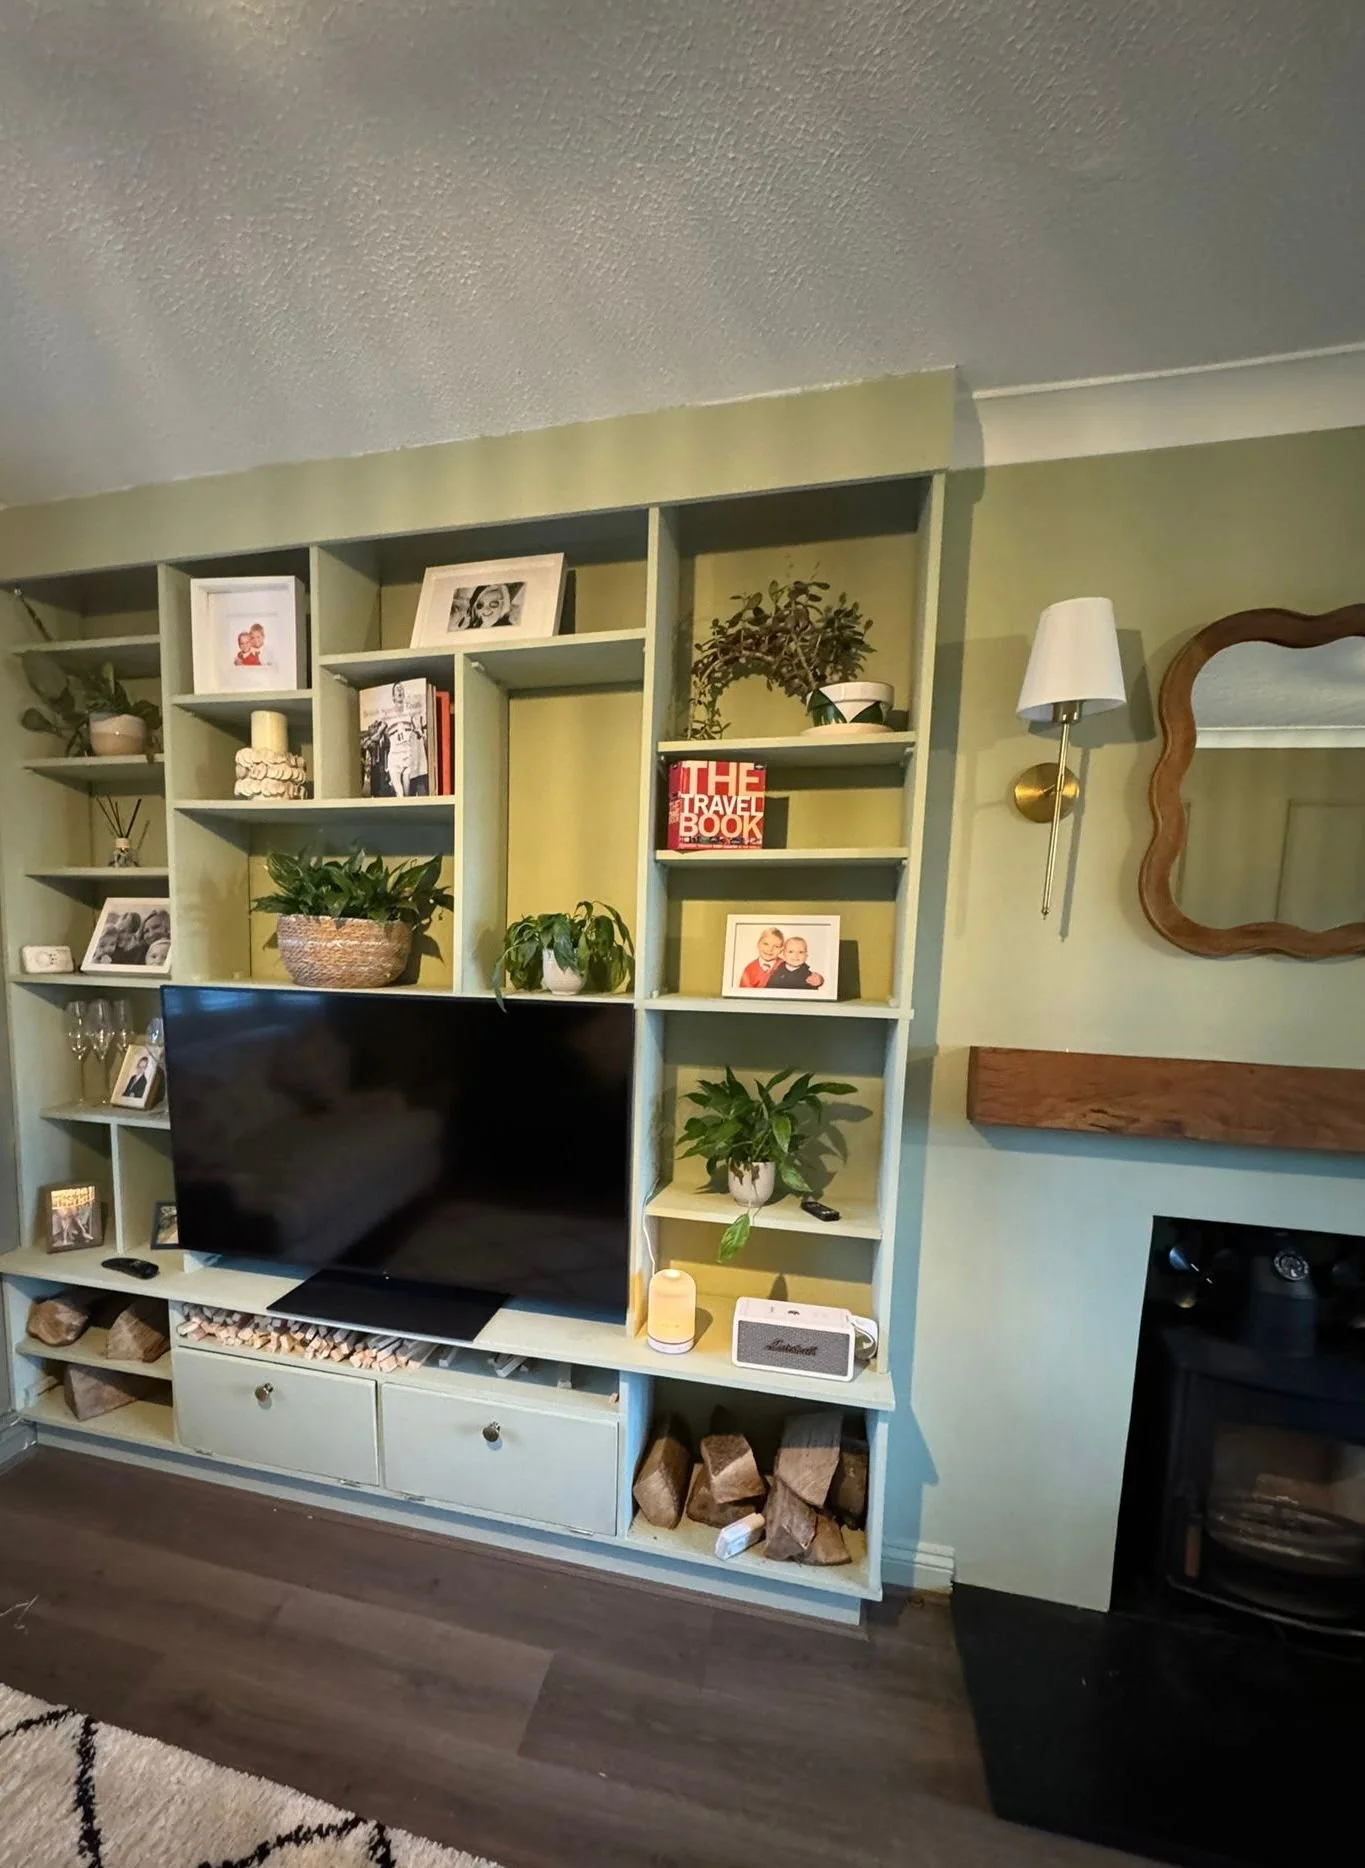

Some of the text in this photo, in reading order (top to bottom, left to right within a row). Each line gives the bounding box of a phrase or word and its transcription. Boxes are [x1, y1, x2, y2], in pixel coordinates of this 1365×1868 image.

[682, 760, 764, 797] THE
[680, 793, 763, 817] TRAVEL
[680, 813, 762, 840] BOOK
